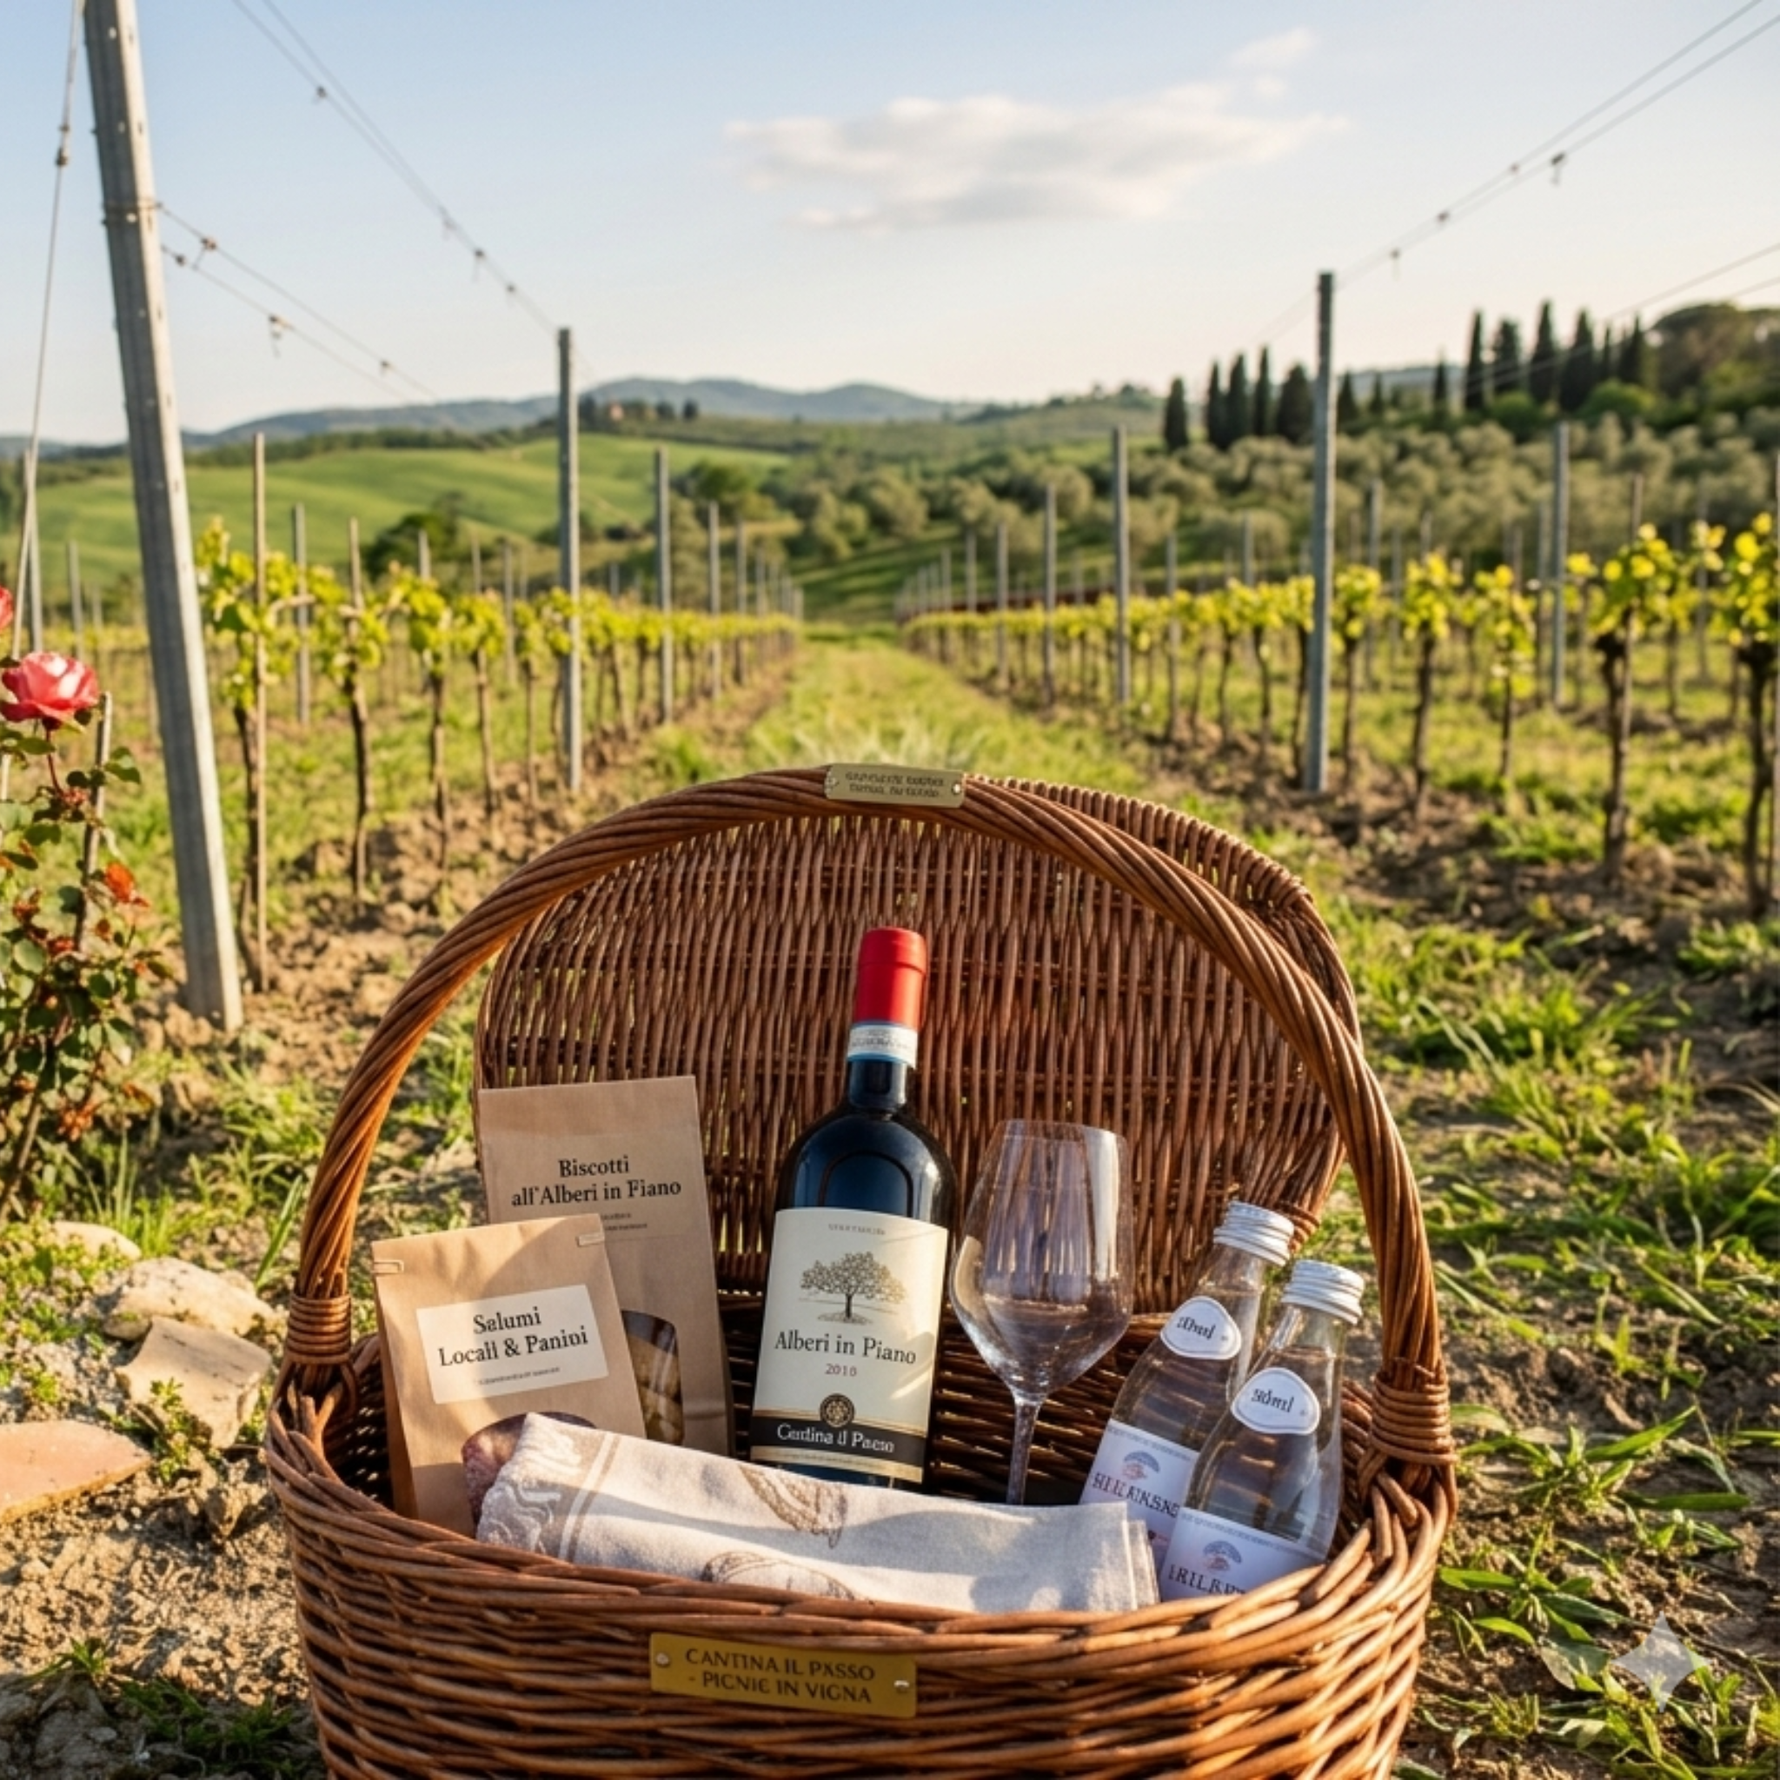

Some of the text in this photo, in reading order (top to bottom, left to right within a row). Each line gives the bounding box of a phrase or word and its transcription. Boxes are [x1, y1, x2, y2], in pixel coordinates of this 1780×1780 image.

[558, 1155, 630, 1178] Biscotti
[603, 1183, 621, 1200] in
[472, 1306, 542, 1334] Salumi
[504, 1338, 521, 1358] &
[774, 1329, 917, 1365] Alberi in Piano
[685, 1648, 779, 1673] CANTINA
[785, 1659, 803, 1676] IL
[776, 1679, 800, 1697] IN
